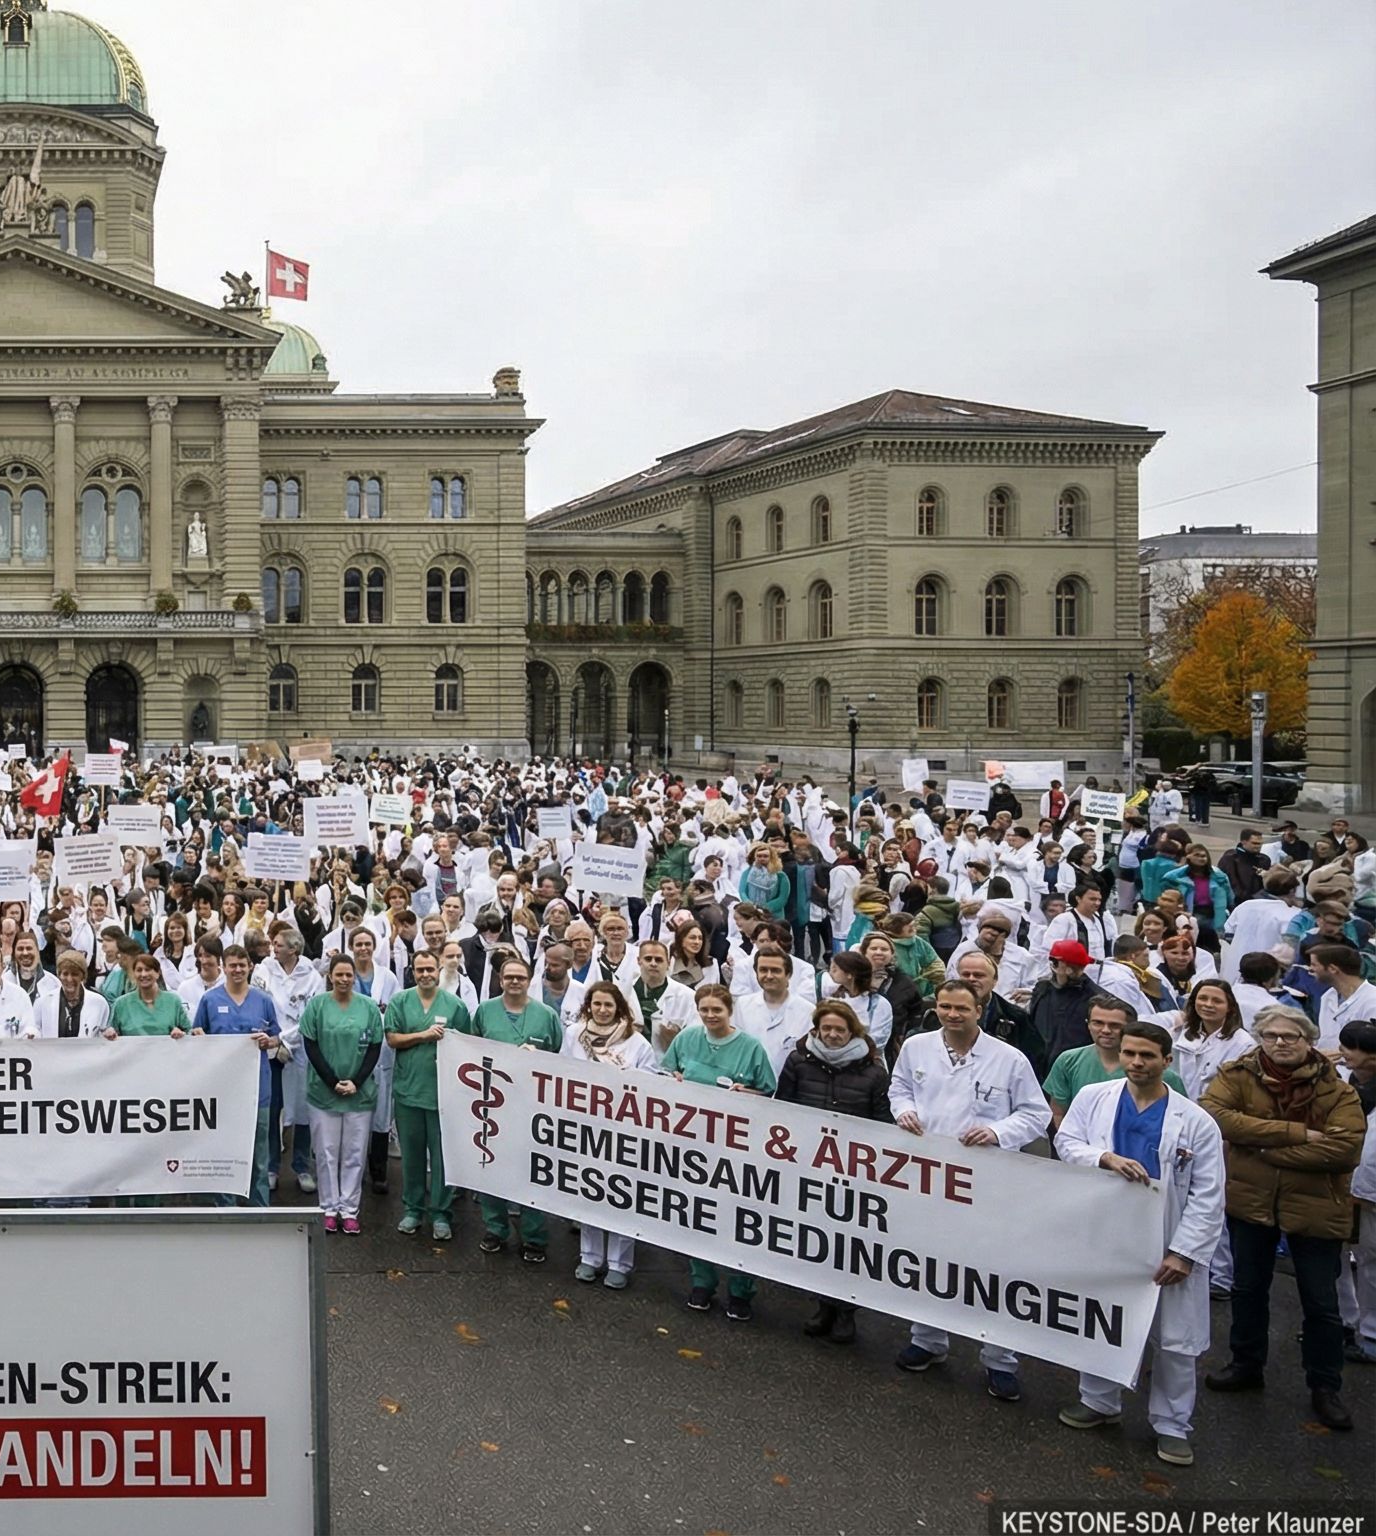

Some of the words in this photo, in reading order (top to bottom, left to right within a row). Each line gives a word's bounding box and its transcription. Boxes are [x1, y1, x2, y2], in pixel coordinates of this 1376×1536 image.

[531, 1071, 750, 1152] TIERÄRZTE
[764, 1125, 798, 1164] &
[811, 1126, 973, 1205] ÄRZTE
[531, 1113, 781, 1205] GEMEINSAM
[798, 1176, 889, 1234] FÜR
[530, 1151, 718, 1236] BESSERE
[734, 1206, 1123, 1348] BEDINGUNGEN
